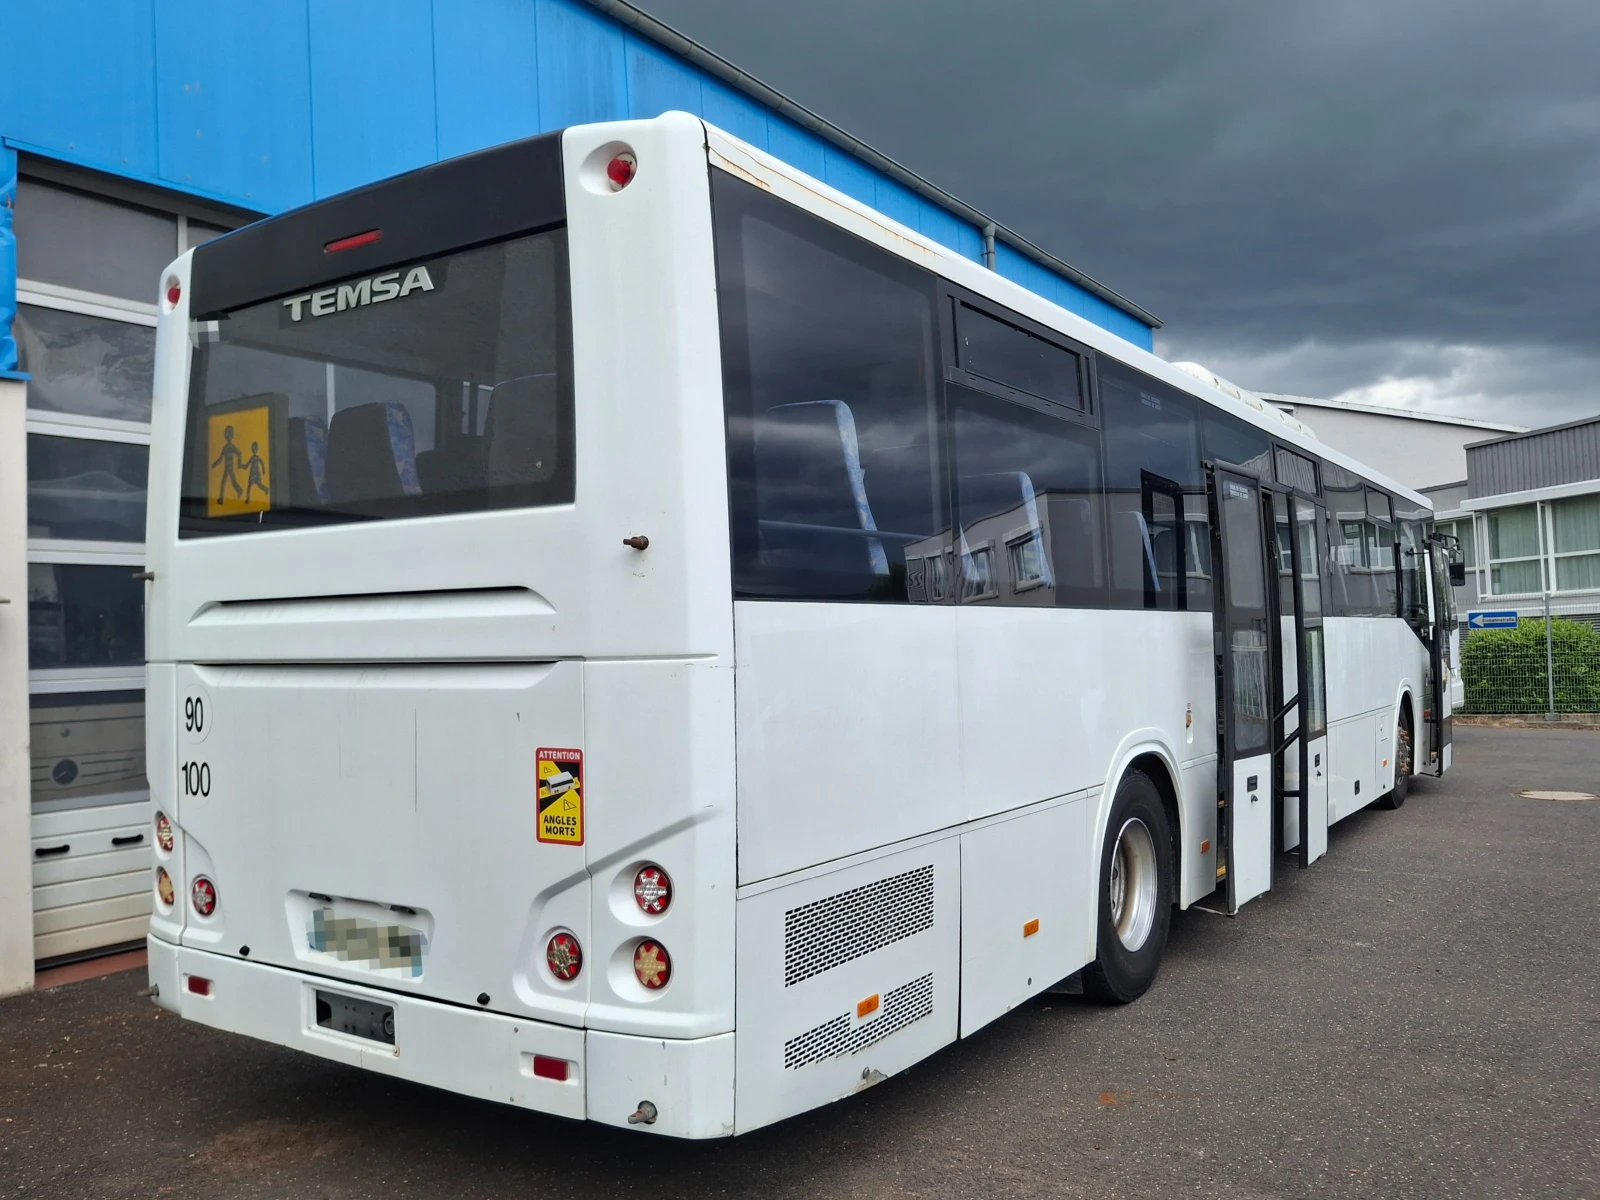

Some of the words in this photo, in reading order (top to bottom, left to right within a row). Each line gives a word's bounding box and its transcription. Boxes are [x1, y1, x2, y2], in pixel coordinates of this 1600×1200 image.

[283, 266, 435, 322] TEMSA
[185, 696, 204, 732] 90
[539, 750, 580, 760] ATTENTION
[181, 761, 211, 797] 100
[543, 815, 577, 826] ANGLES
[545, 826, 576, 836] MORTS
